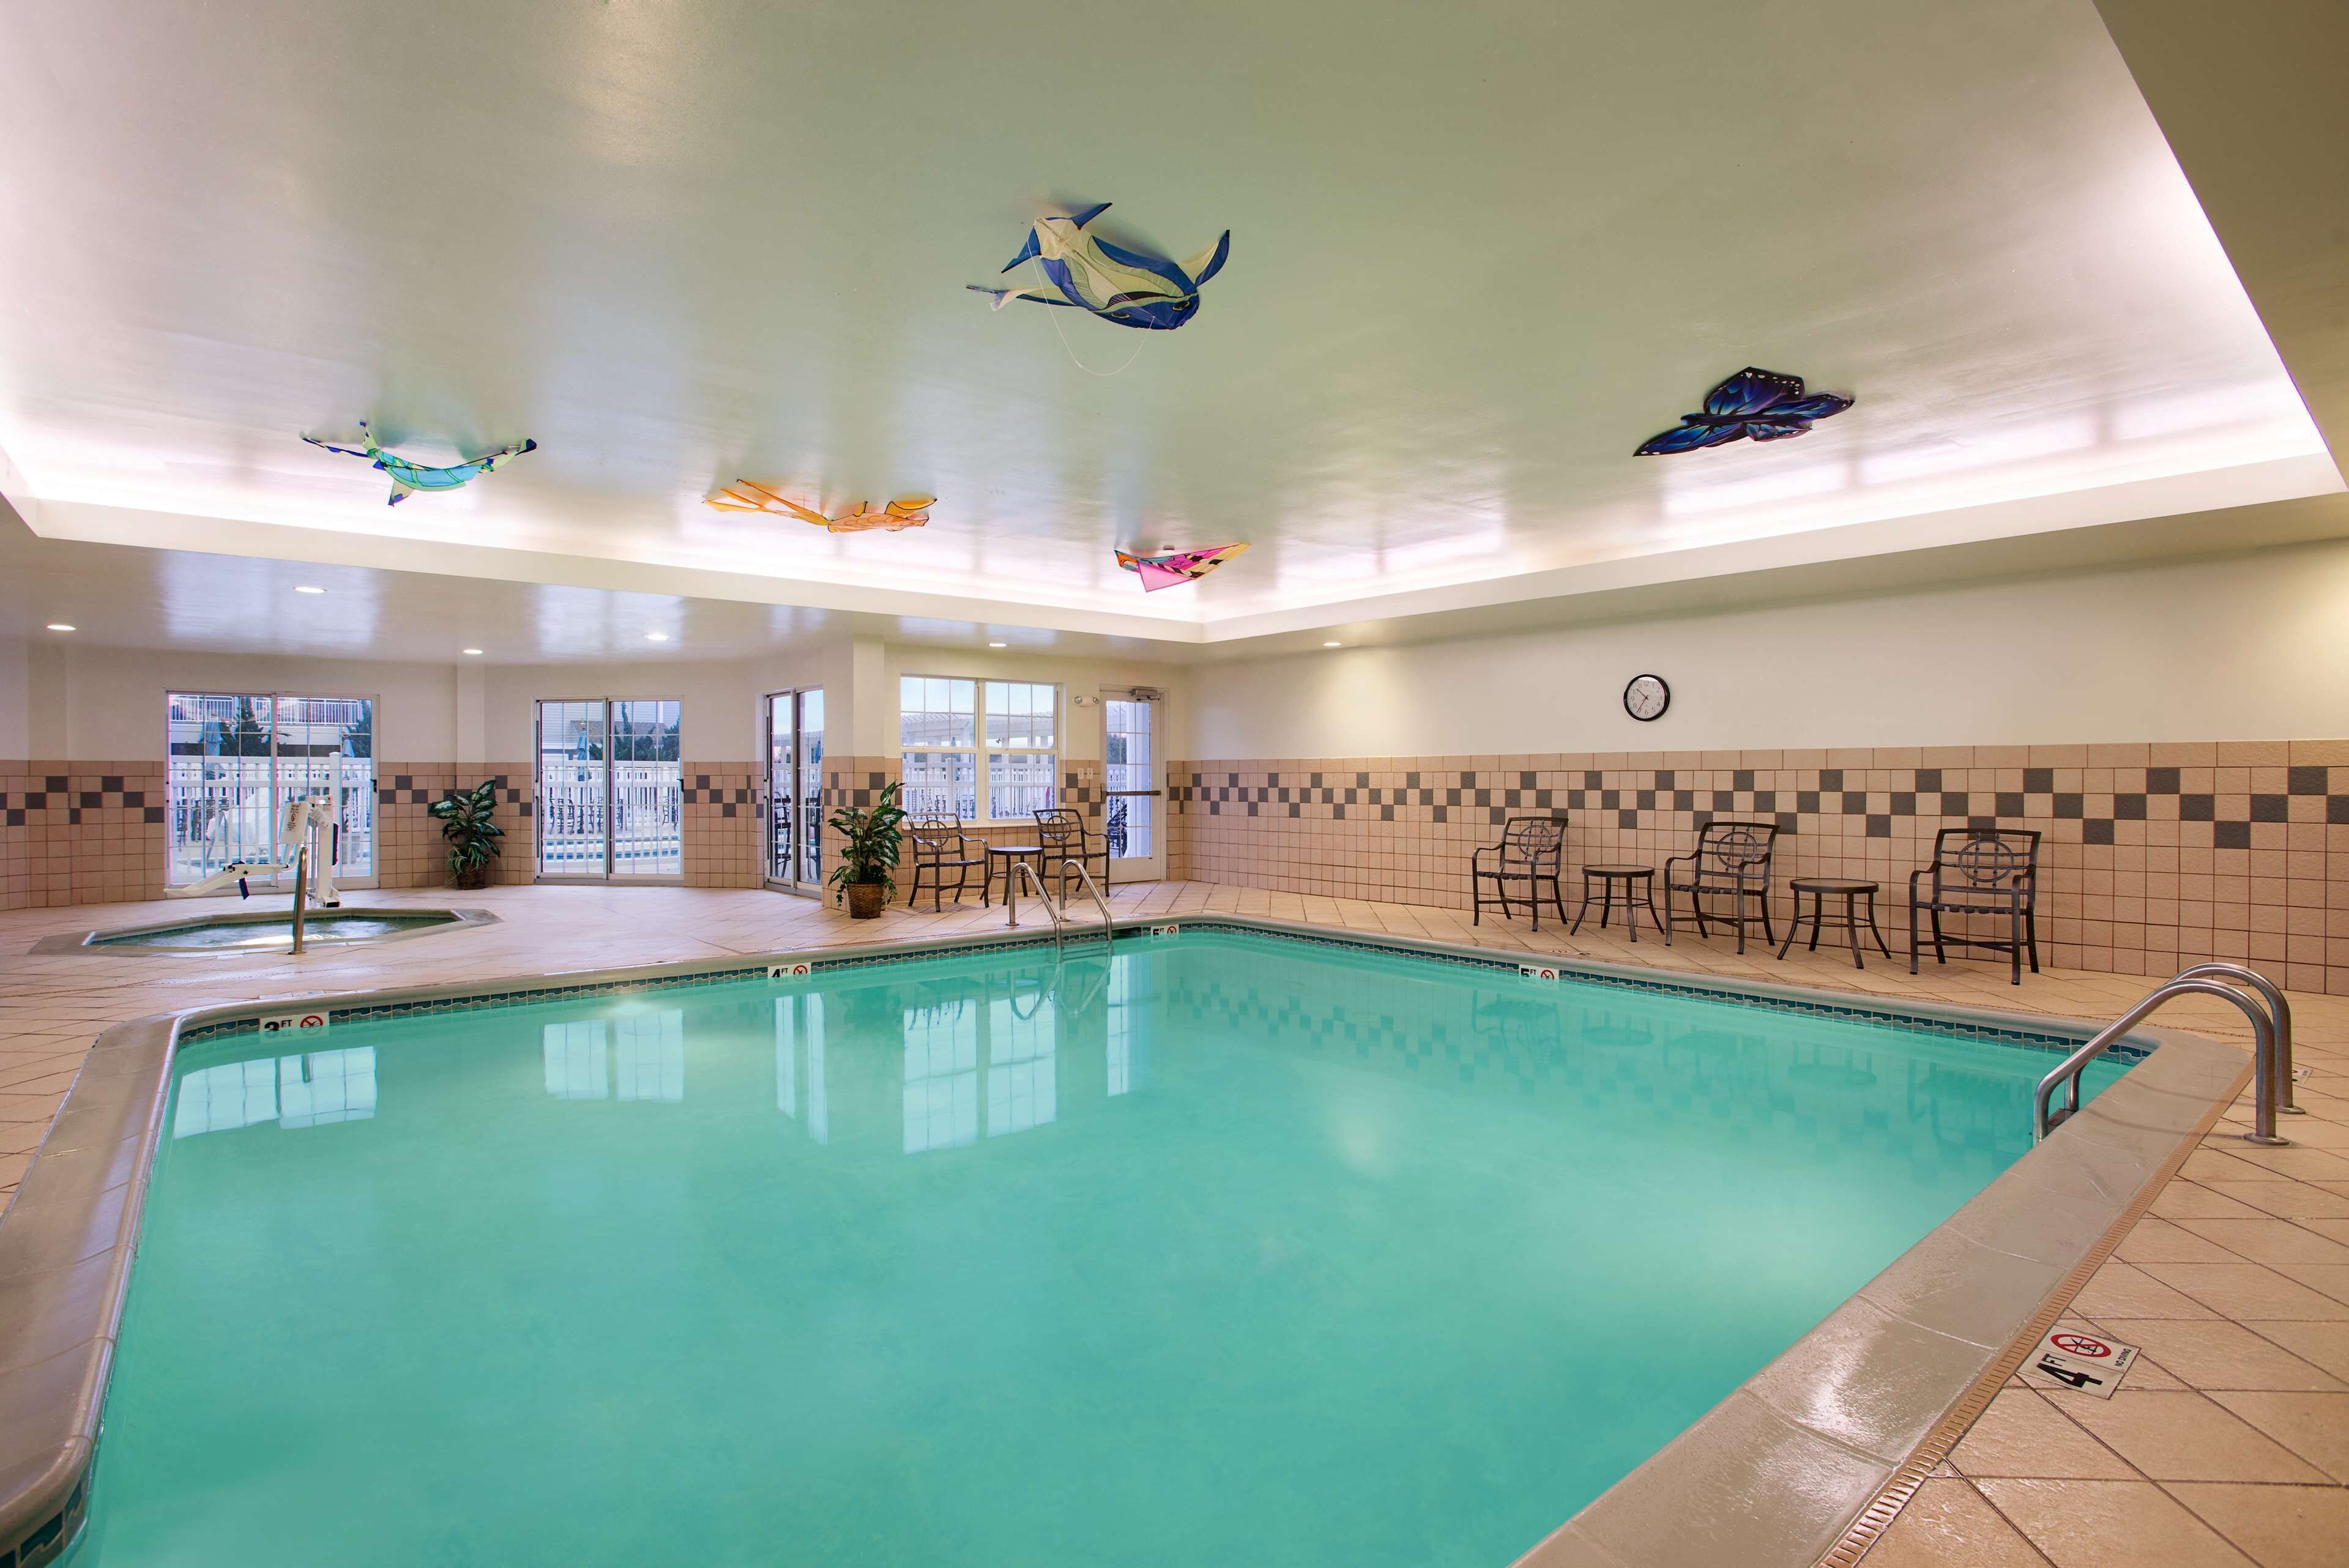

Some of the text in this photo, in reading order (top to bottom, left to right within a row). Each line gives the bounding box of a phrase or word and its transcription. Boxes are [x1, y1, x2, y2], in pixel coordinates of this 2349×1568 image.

[1521, 968, 1530, 977] 5
[2118, 1348, 2131, 1361] DIVING
[2036, 1353, 2103, 1388] 4 FT
